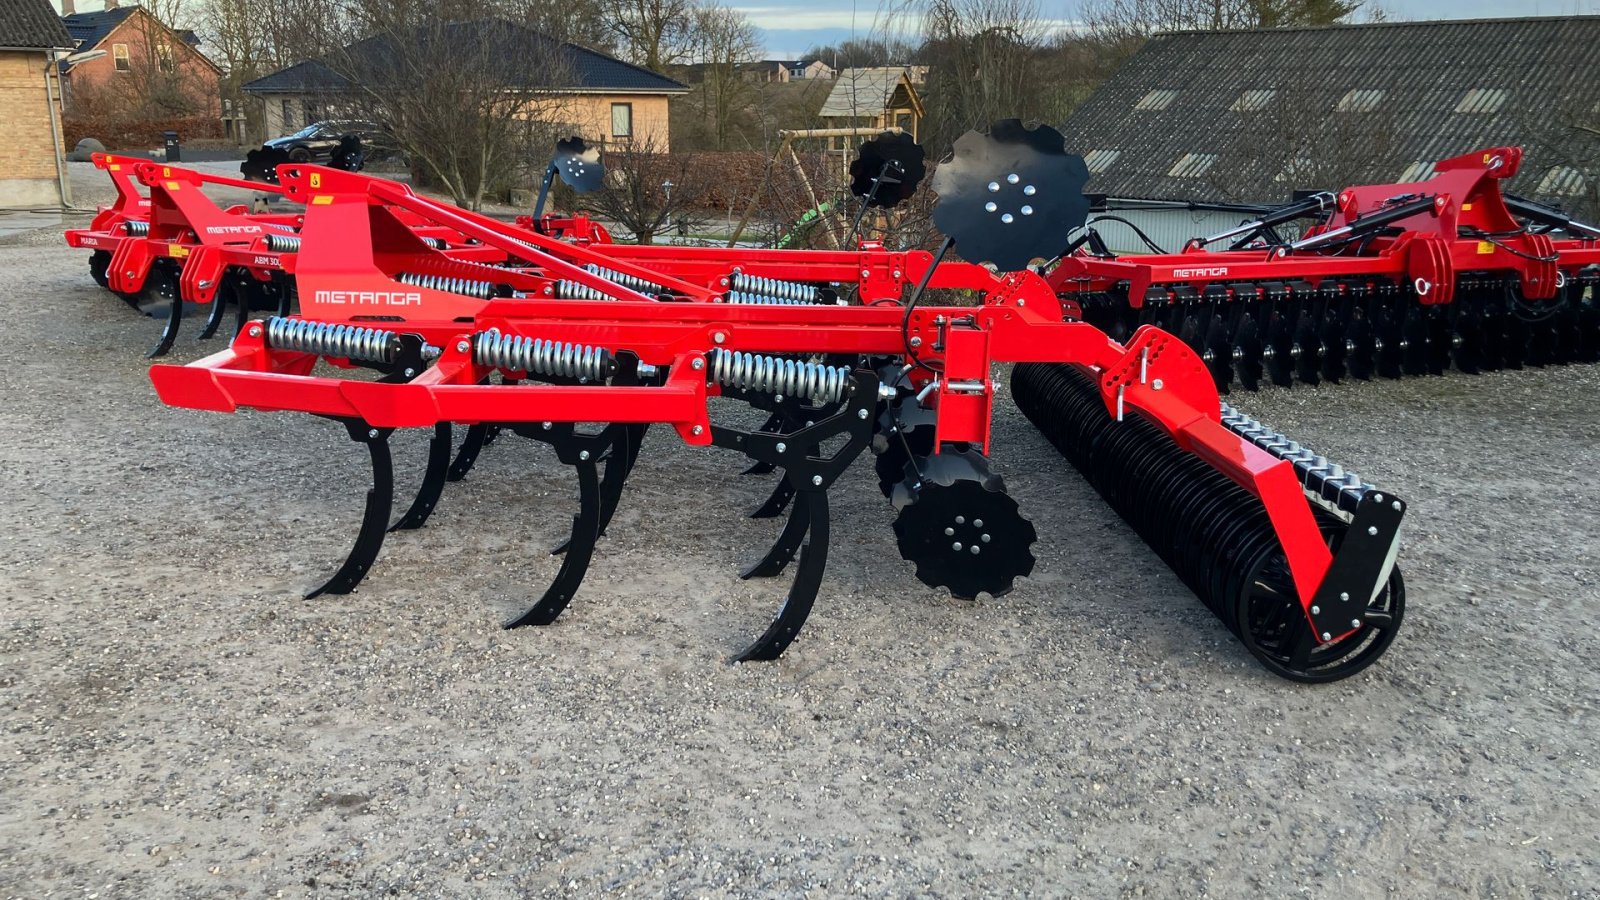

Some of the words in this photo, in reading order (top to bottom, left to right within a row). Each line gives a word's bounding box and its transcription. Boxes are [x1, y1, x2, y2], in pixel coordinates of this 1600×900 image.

[206, 226, 262, 234] METANGA
[254, 256, 269, 266] ABM
[1173, 267, 1228, 278] METANGA
[315, 290, 421, 306] METANGA
